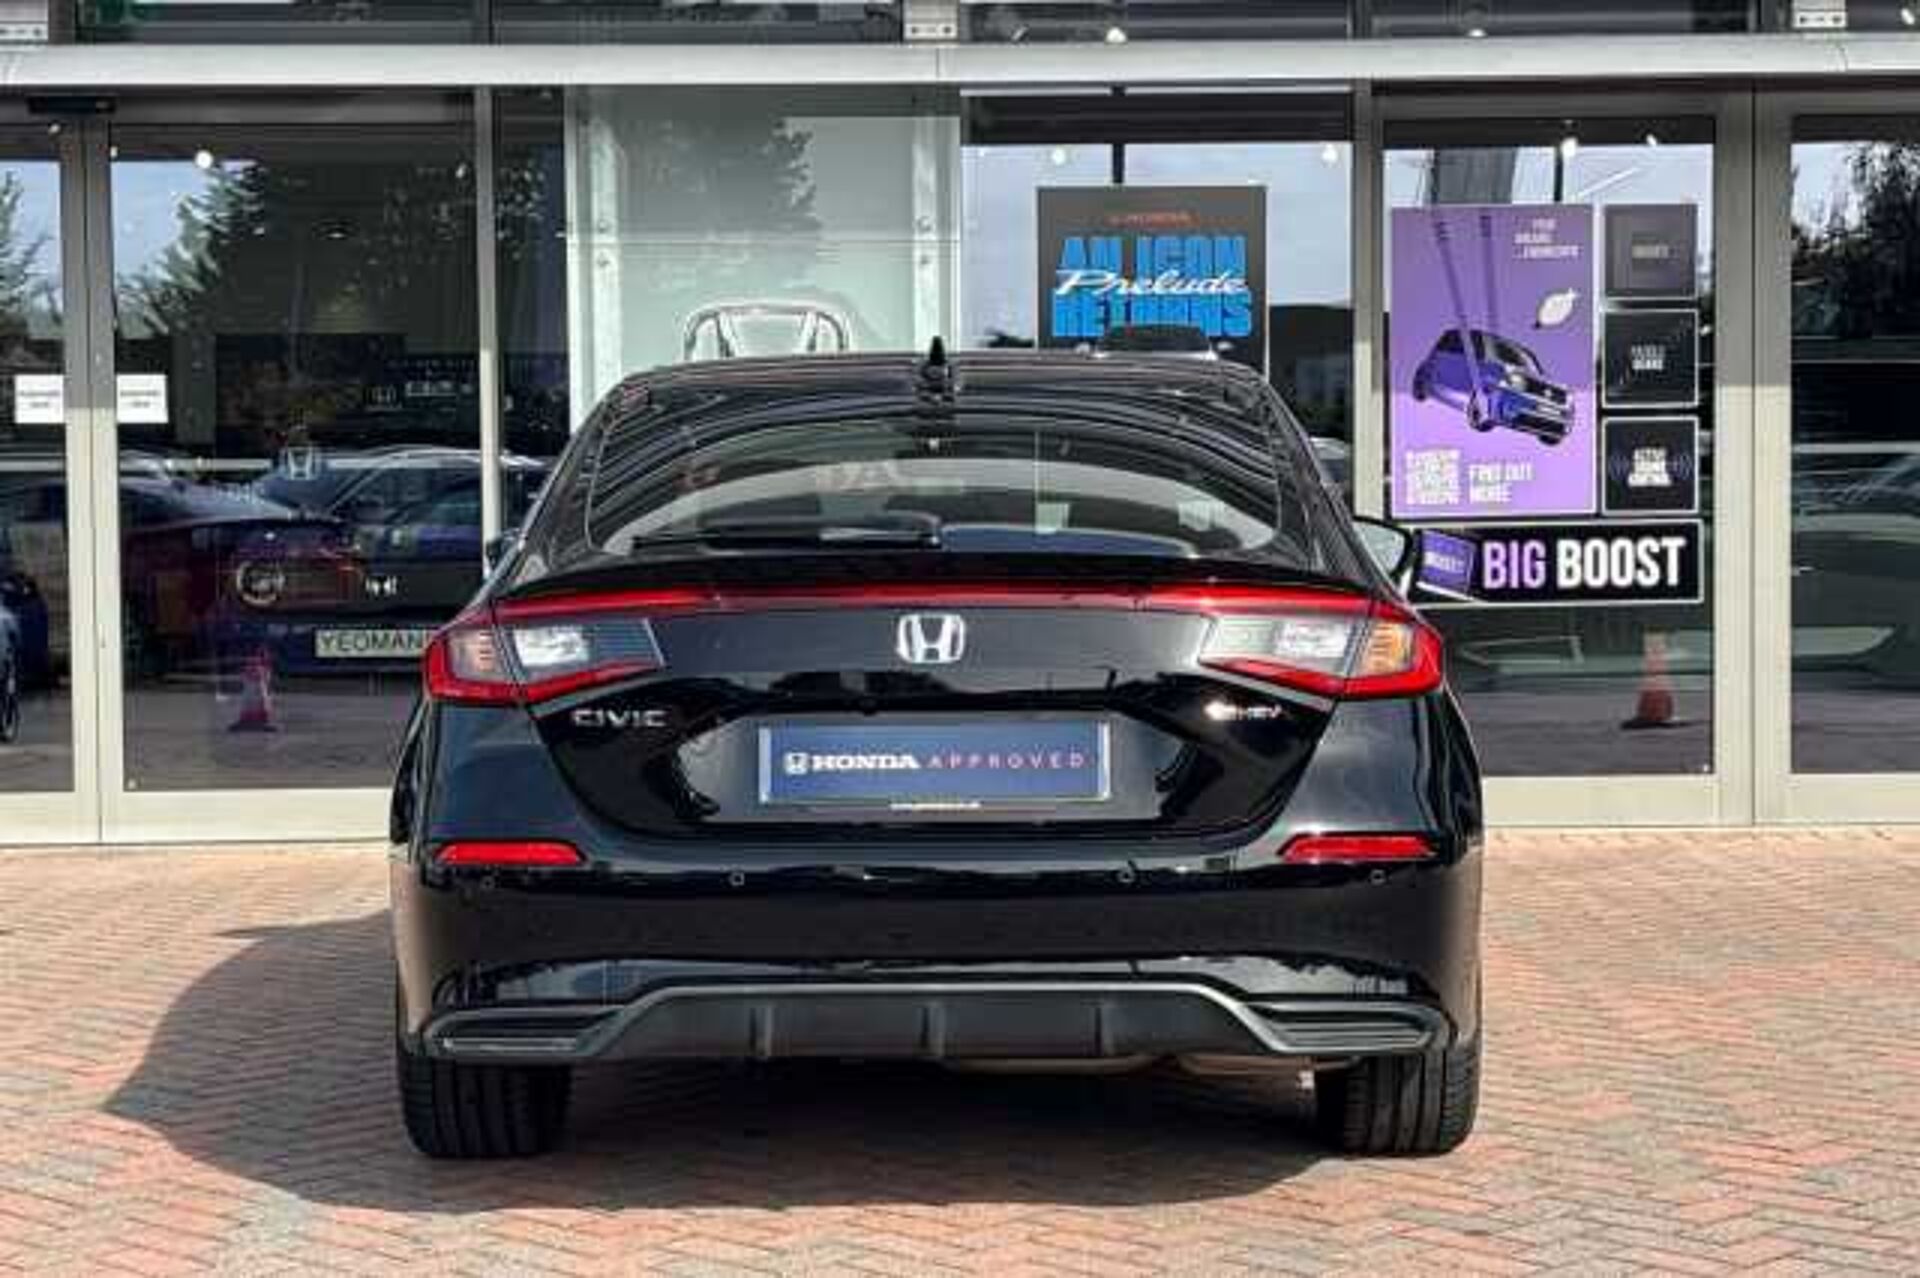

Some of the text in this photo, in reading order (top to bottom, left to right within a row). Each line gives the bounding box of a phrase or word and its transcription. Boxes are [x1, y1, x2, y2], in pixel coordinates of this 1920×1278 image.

[1055, 268, 1250, 295] Prelude
[1482, 539, 1547, 590] BIG
[1556, 536, 1688, 589] BOOST
[570, 708, 668, 728] CIVIC
[811, 752, 1086, 770] HONDA APPROVED
